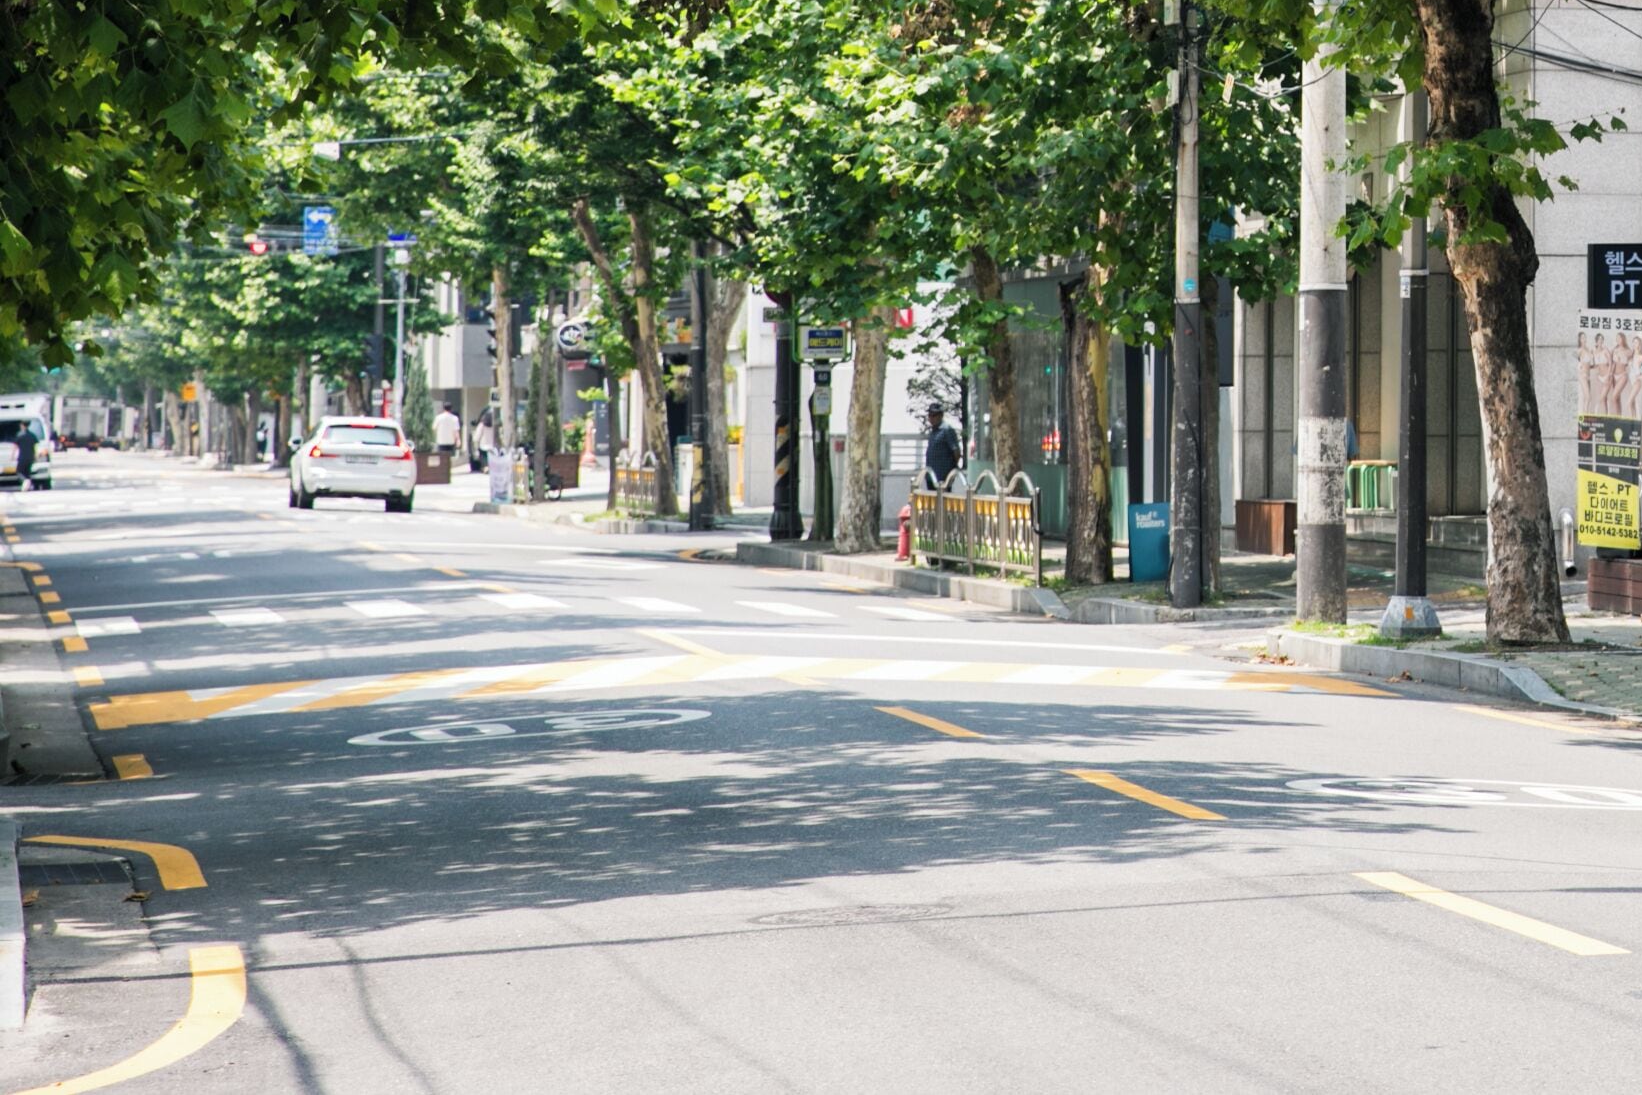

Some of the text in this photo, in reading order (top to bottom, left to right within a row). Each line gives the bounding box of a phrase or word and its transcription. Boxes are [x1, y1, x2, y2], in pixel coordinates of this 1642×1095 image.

[1610, 280, 1640, 304] PT
[1615, 318, 1642, 332] 3호점
[1588, 480, 1609, 495] 헬스
[1617, 483, 1632, 496] PT
[1590, 496, 1629, 512] 다이어트
[1584, 510, 1633, 527] 바디프로필
[1579, 524, 1639, 540] 010-5142-5382
